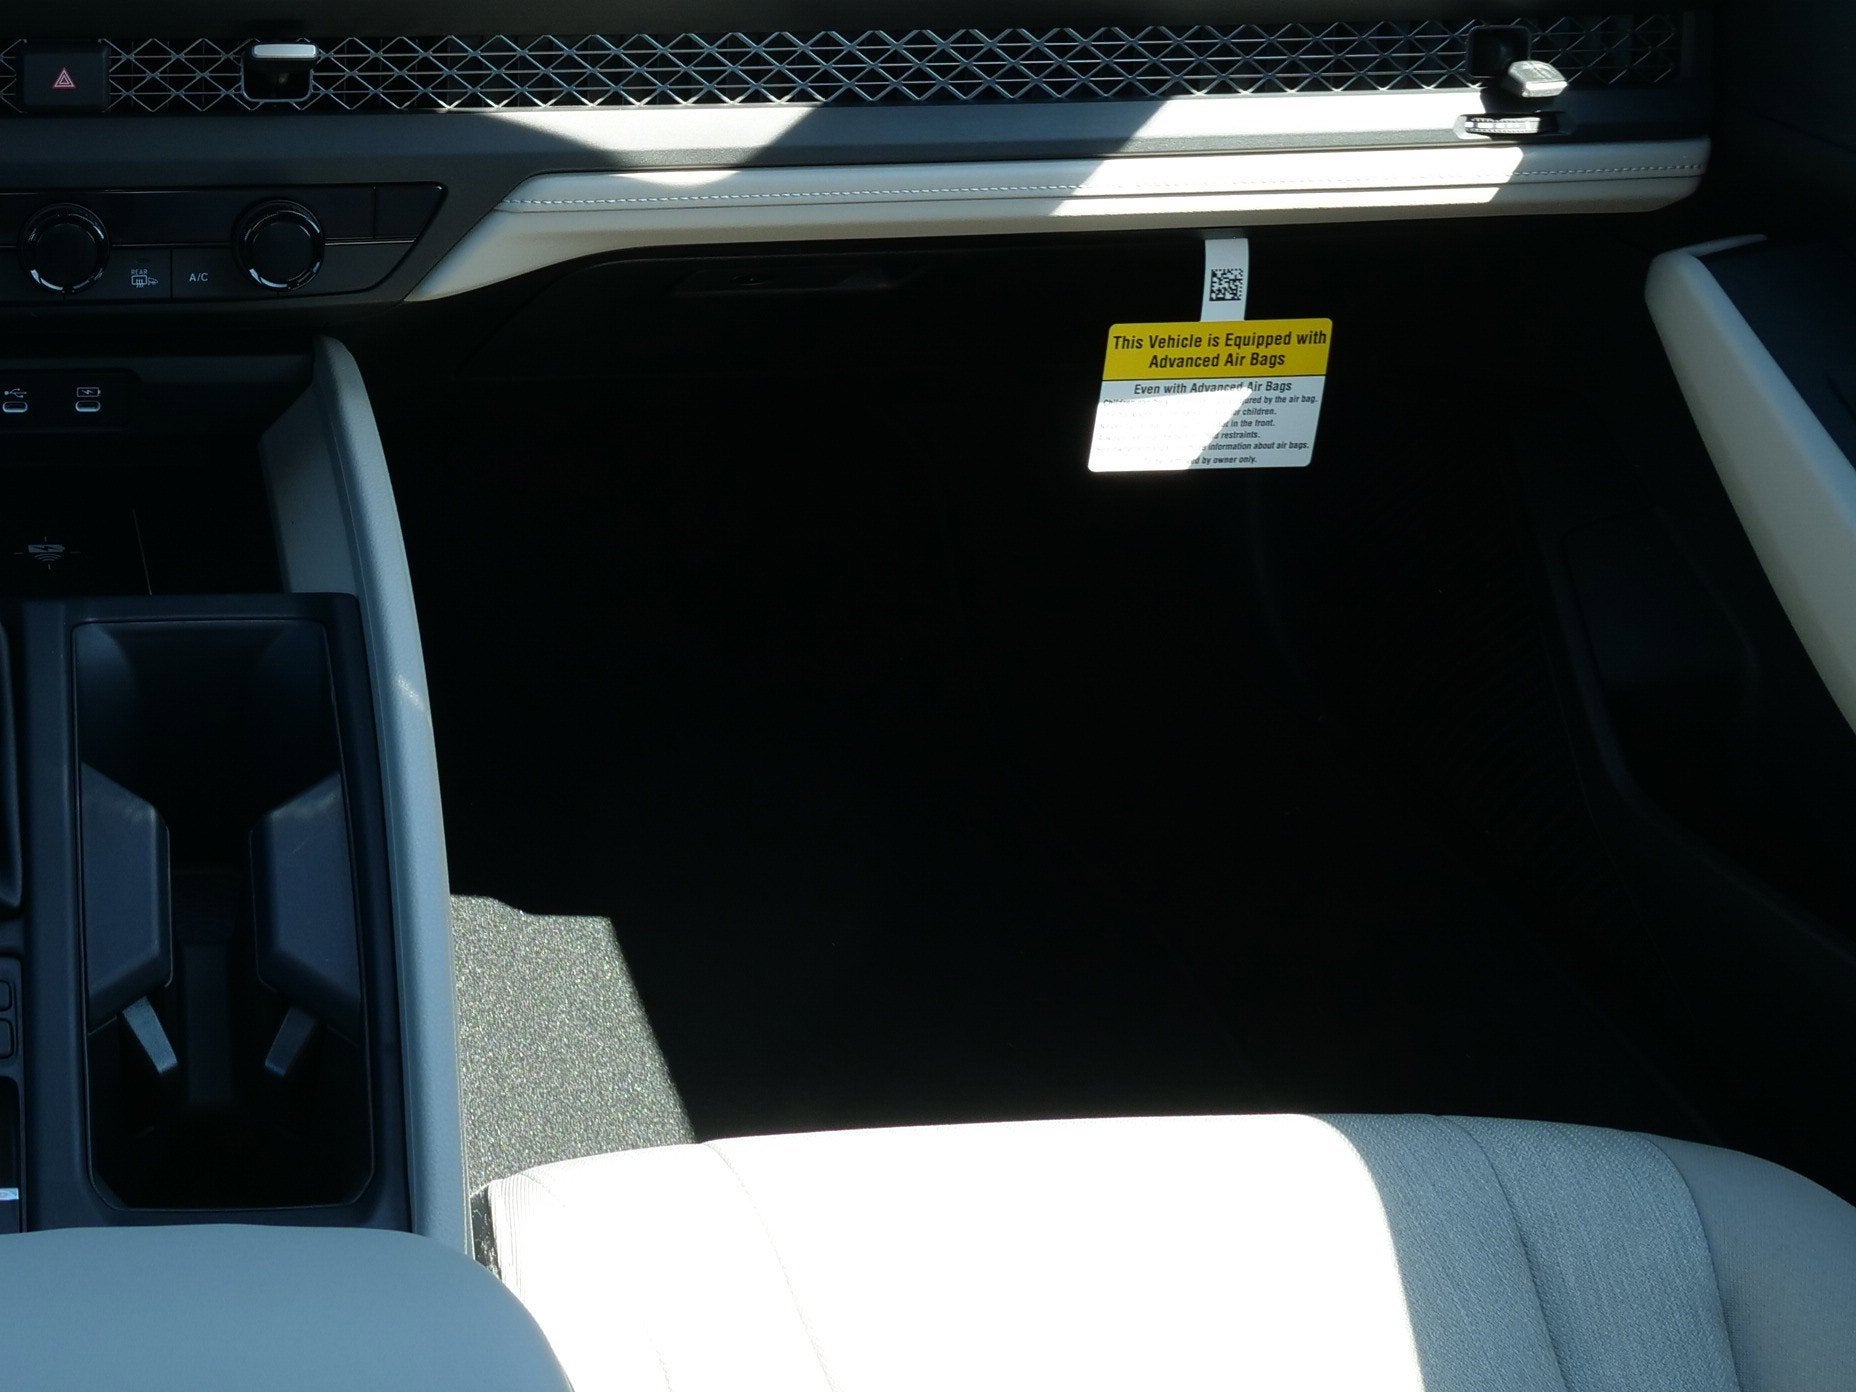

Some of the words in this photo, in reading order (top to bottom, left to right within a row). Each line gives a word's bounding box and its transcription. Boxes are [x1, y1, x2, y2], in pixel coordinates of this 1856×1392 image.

[189, 272, 208, 282] A/C
[1113, 335, 1144, 350] This
[1149, 333, 1201, 349] Vehicle
[1207, 334, 1220, 348] is
[1225, 332, 1292, 350] Equipped
[1296, 331, 1327, 346] with
[1148, 354, 1220, 369] Advanced
[1224, 353, 1246, 367] Air
[1250, 353, 1285, 369] Bags
[1134, 384, 1160, 395] Even
[1164, 383, 1187, 394] with
[1190, 382, 1243, 393] Advanced
[1246, 381, 1262, 392] Air
[1265, 381, 1292, 394] Bags
[1263, 396, 1273, 405] by
[1274, 395, 1287, 404] the
[1288, 395, 1300, 404] air
[1301, 394, 1318, 405] bag.
[1242, 407, 1277, 416] children.
[1230, 419, 1240, 427] in
[1241, 419, 1253, 427] the
[1255, 419, 1275, 427] front.
[1221, 430, 1261, 439] restraints.
[1208, 442, 1252, 451] information
[1253, 441, 1275, 450] about
[1276, 442, 1288, 450] air
[1289, 441, 1310, 451] bags.
[1201, 456, 1211, 465] by
[1213, 456, 1237, 464] owner
[1238, 455, 1257, 465] only.
